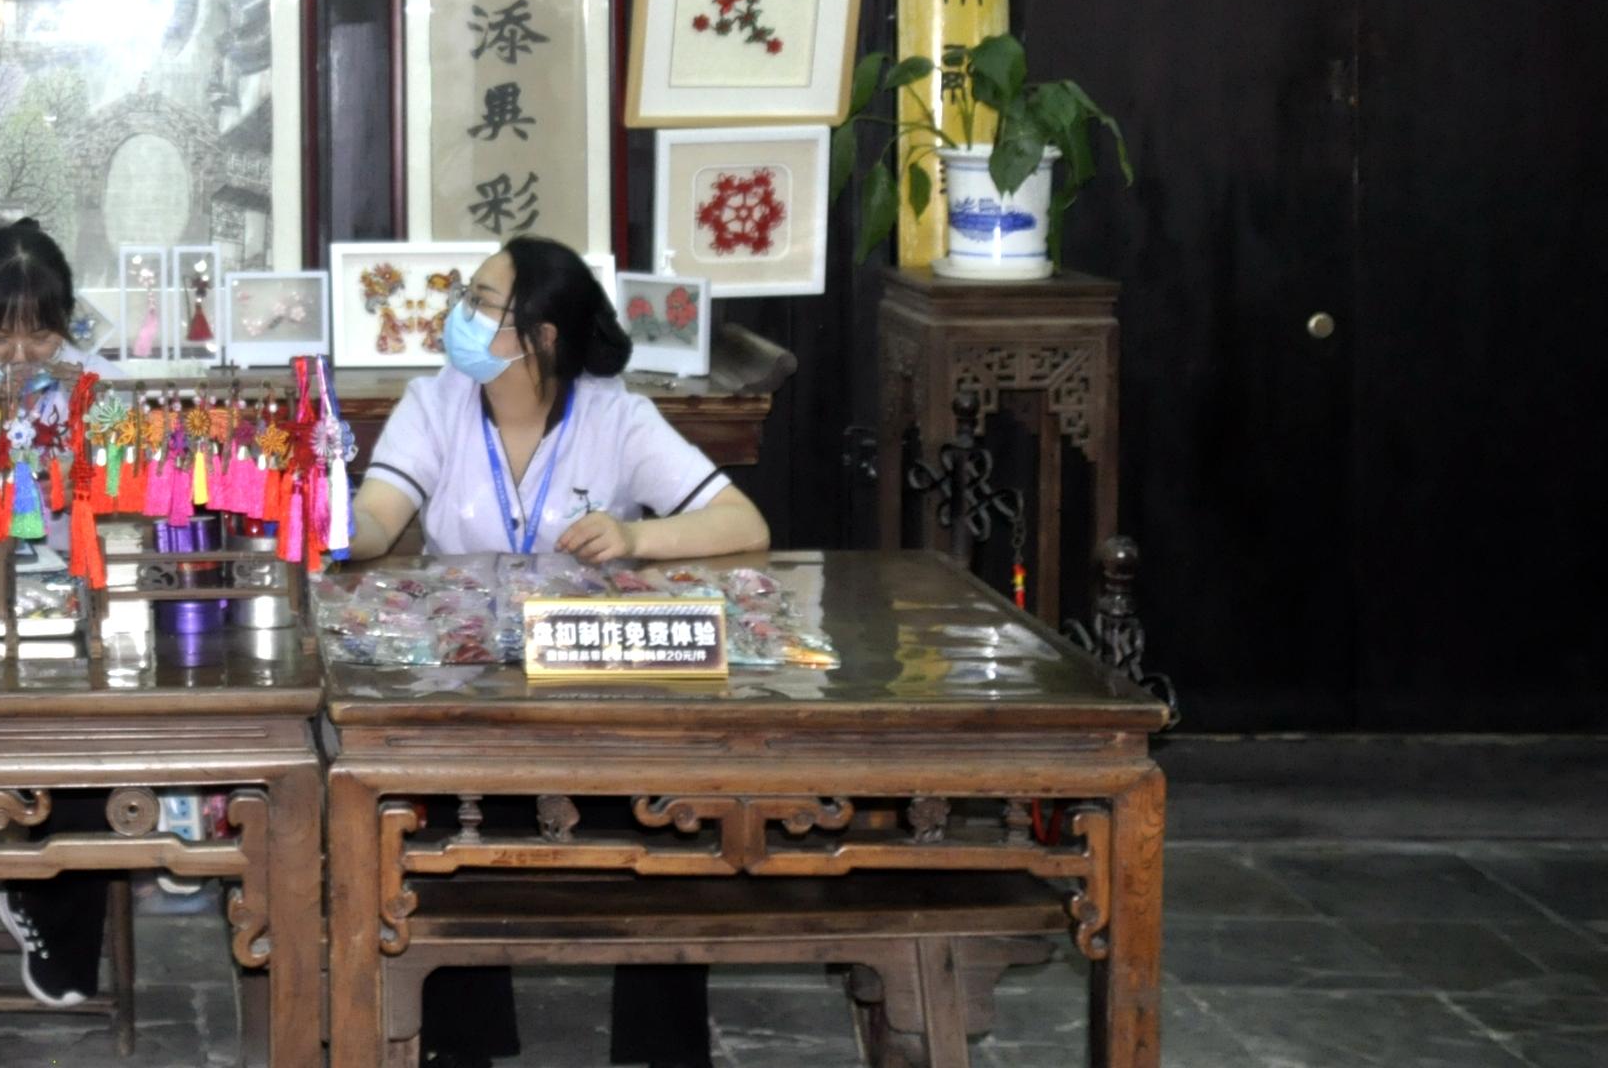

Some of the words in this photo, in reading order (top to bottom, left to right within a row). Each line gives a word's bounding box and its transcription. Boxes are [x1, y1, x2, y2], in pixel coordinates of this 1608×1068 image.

[533, 620, 717, 647] 盘扣制作免费体验
